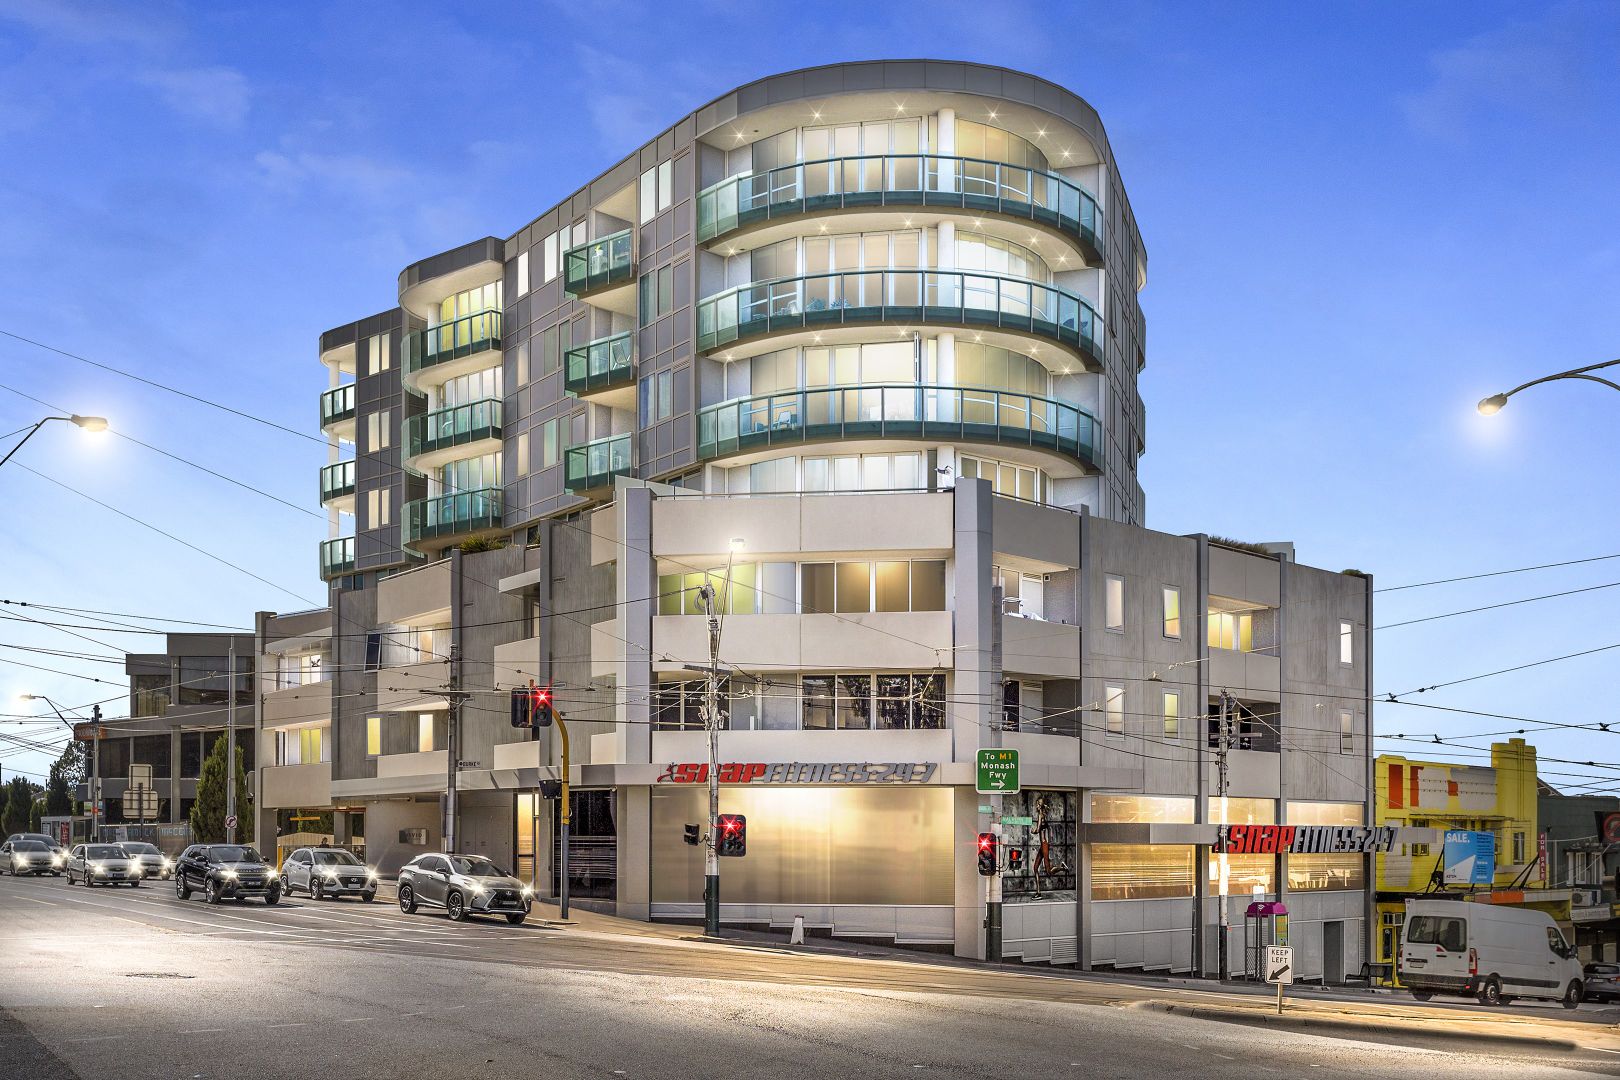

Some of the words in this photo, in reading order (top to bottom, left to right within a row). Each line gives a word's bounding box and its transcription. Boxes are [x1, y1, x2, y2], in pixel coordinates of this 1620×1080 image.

[985, 752, 995, 760] To
[999, 752, 1012, 760] M1
[989, 771, 1007, 779] Fwy
